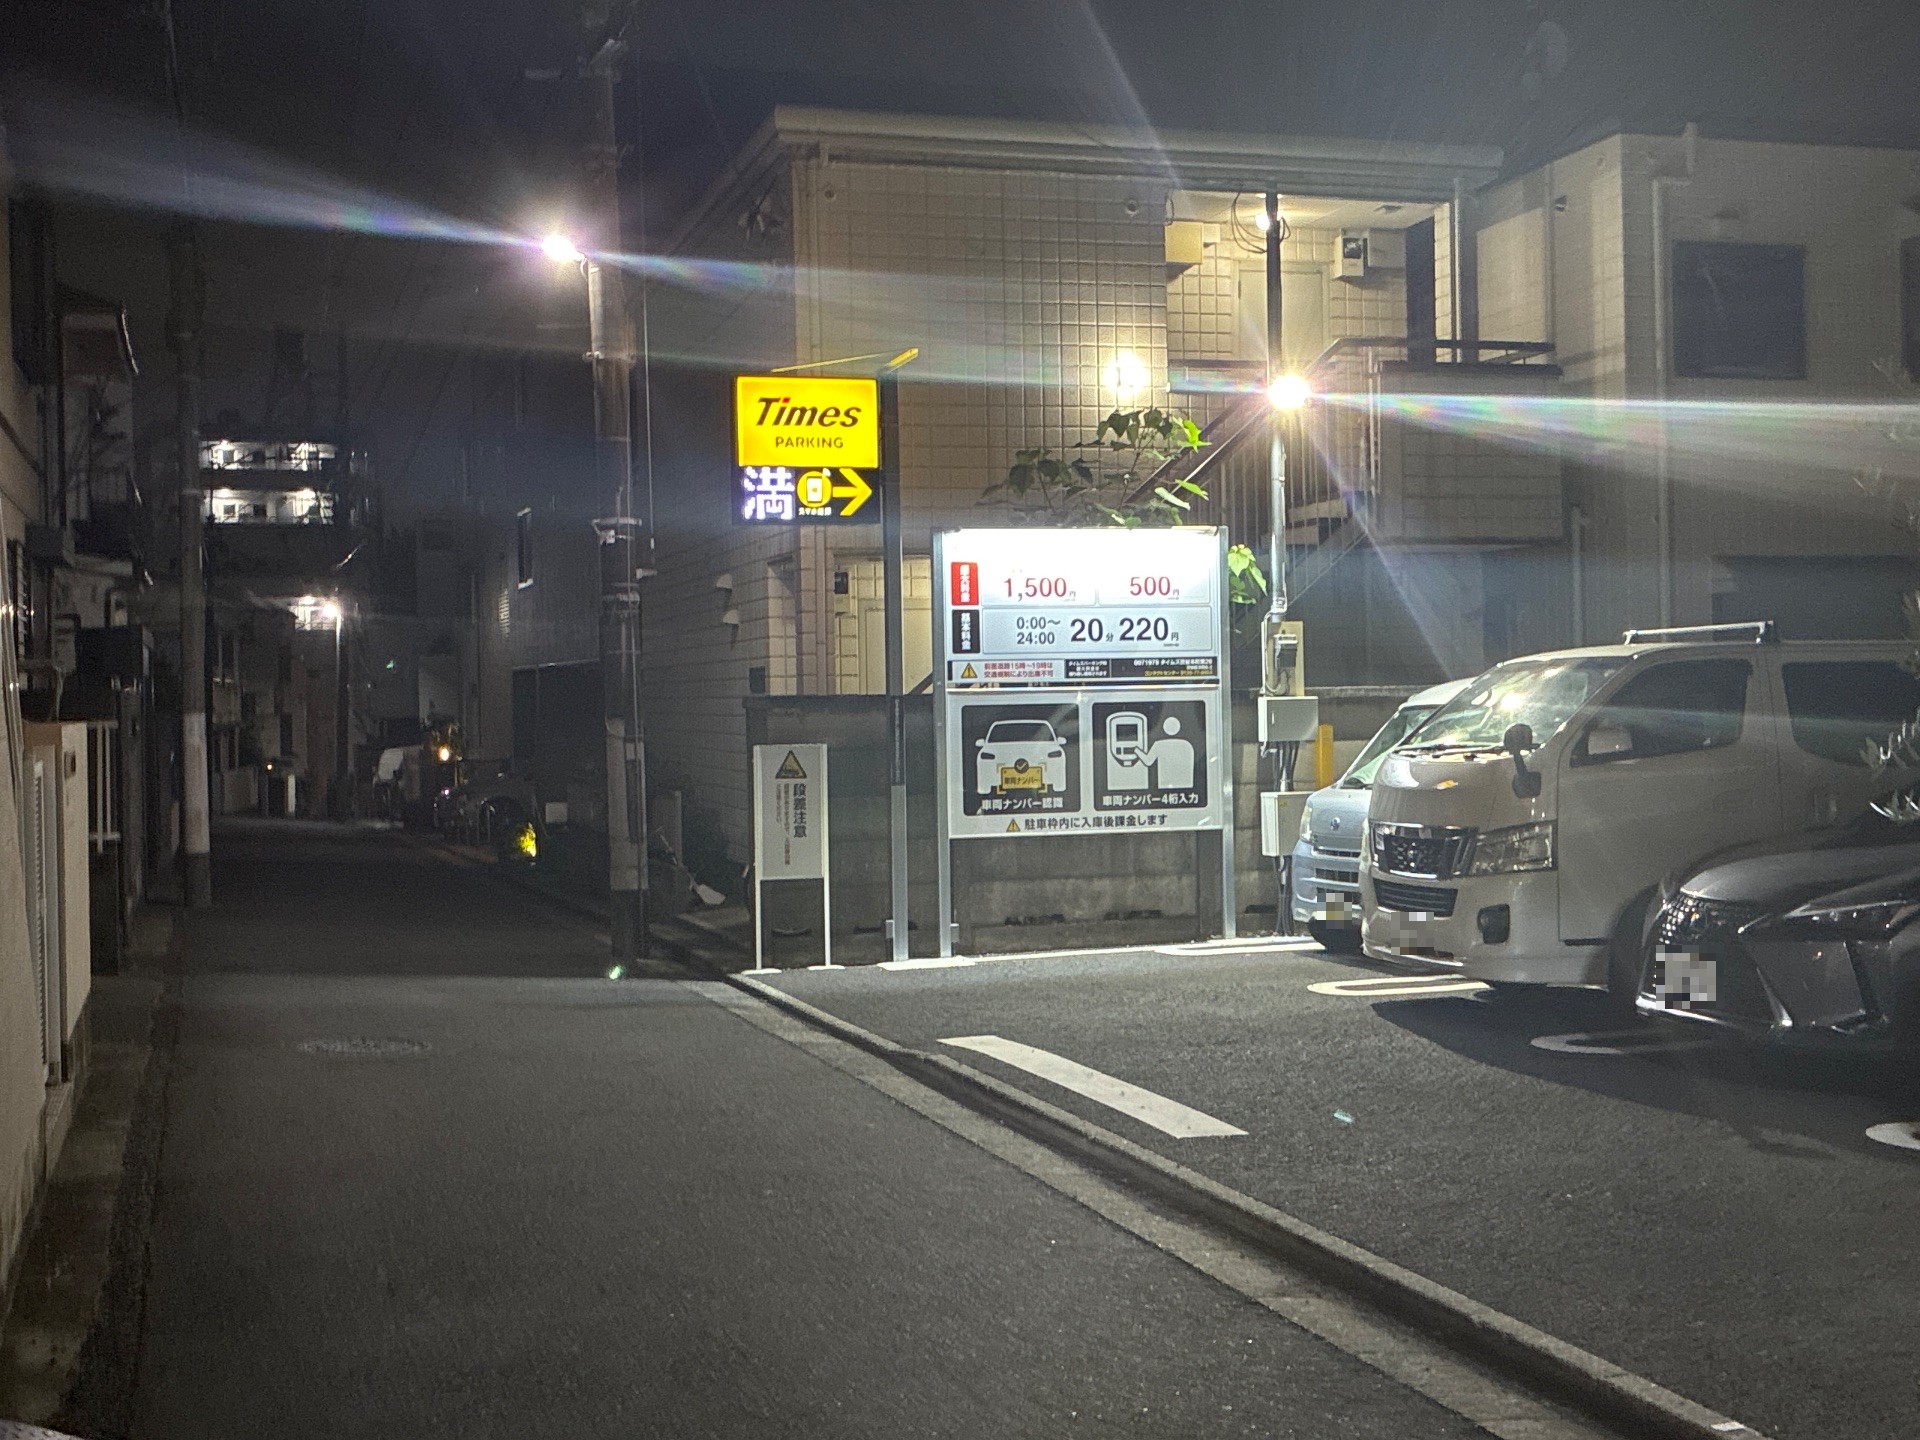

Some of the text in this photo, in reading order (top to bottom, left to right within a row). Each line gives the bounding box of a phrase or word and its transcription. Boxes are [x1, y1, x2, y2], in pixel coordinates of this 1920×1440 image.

[756, 397, 861, 428] Times
[775, 436, 844, 449] PARKING
[743, 466, 796, 520] 満
[1016, 631, 1055, 645] 24:00
[1102, 793, 1199, 808] 車両ナンバー4桁入力
[1024, 814, 1168, 831] 駐車枠内に入庫後課金します
